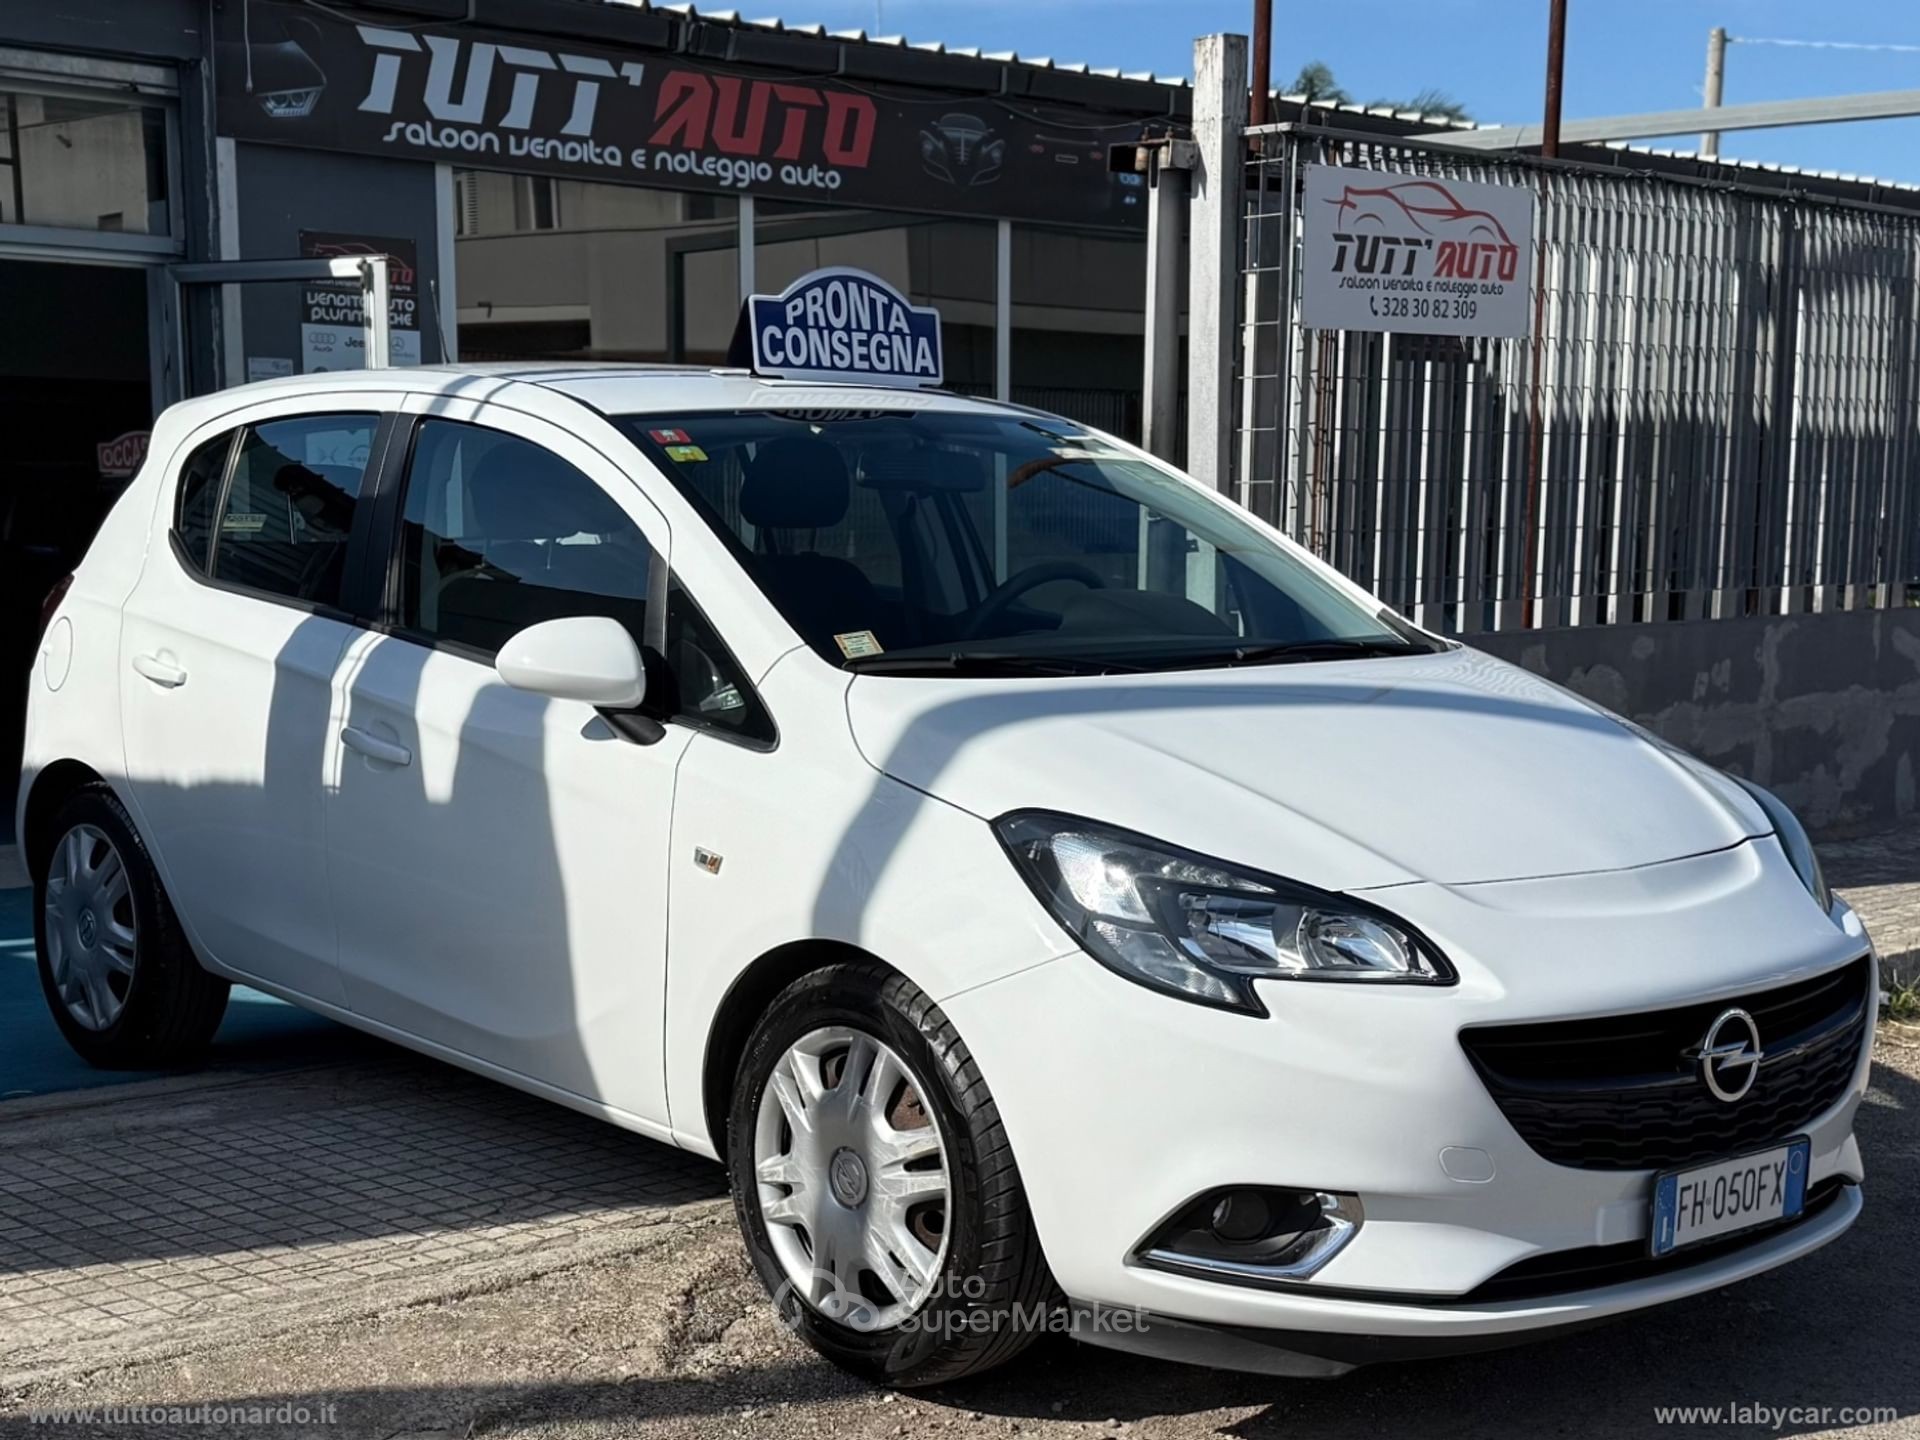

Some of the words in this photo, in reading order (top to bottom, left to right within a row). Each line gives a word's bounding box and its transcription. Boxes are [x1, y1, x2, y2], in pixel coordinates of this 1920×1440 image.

[355, 25, 645, 137] TUTT'
[648, 70, 878, 168] AUTO
[383, 120, 500, 154] saloon
[509, 134, 622, 167] vendita
[654, 150, 773, 188] noleggio
[780, 163, 842, 190] auto
[1433, 241, 1519, 282] AUTO
[785, 280, 911, 334] PRONTA
[1339, 276, 1380, 291] saloon
[1382, 278, 1424, 293] vendita
[1434, 280, 1478, 299] noleggio
[1480, 283, 1504, 296] auto
[1382, 297, 1409, 317] 328
[1412, 298, 1430, 318] 30
[1432, 299, 1449, 319] 82
[1452, 300, 1478, 320] 309
[762, 325, 937, 375] CONSEGNA
[102, 436, 147, 467] OCCA
